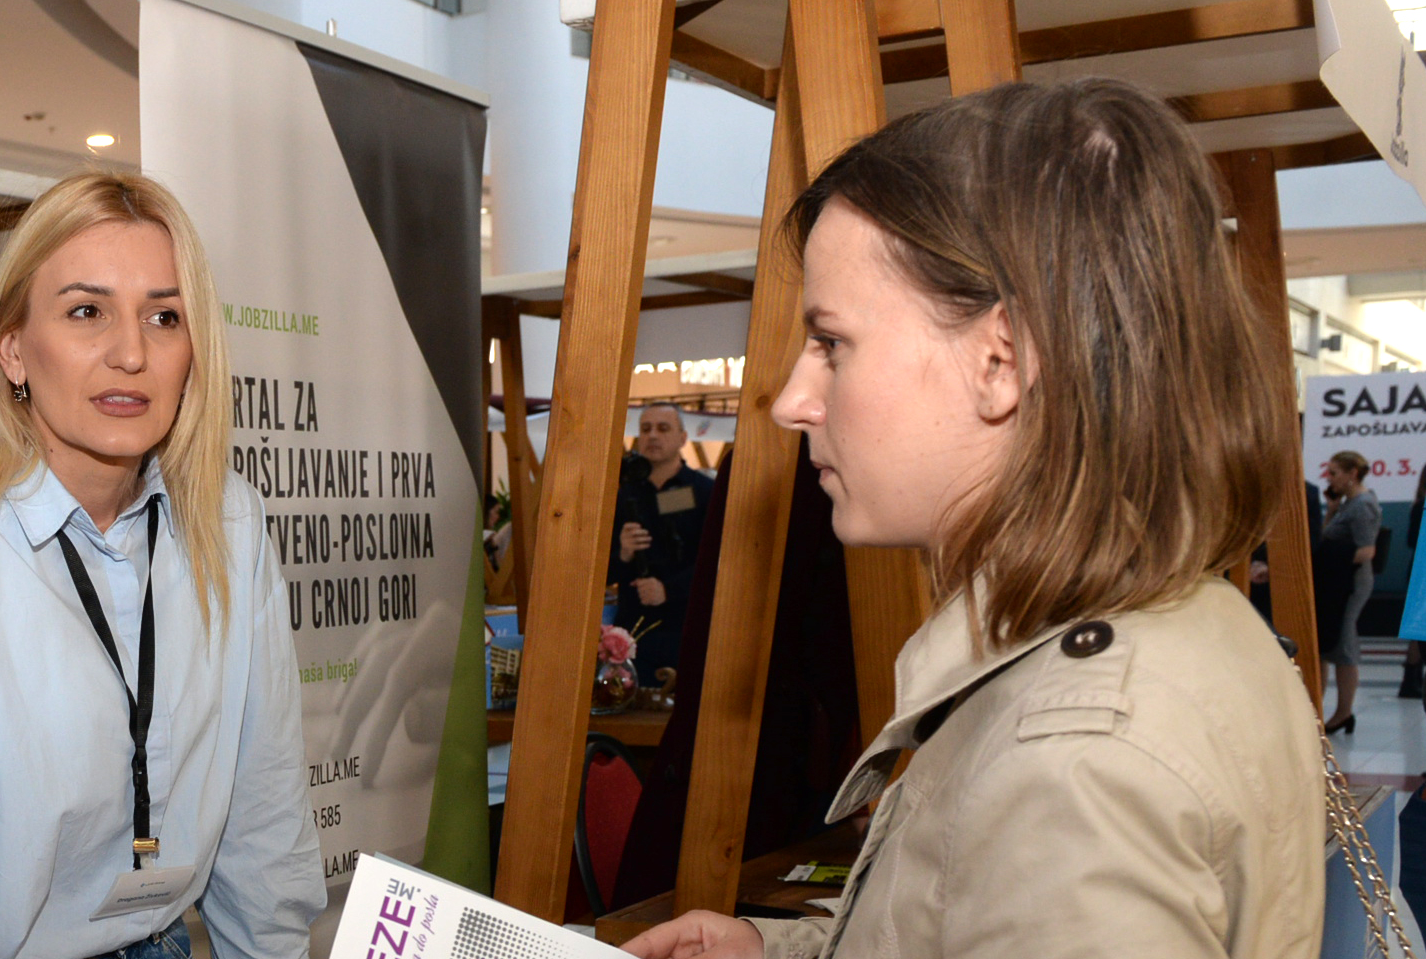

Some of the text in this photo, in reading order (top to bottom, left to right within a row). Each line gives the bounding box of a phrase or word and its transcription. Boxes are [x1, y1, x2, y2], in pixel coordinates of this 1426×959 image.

[294, 380, 318, 432] ZA
[377, 451, 384, 498] I
[391, 452, 436, 498] PRVA
[289, 574, 417, 631] U CRNOJ GORI
[327, 658, 358, 684] briga!
[309, 756, 360, 787] ZILLA.ME
[321, 804, 341, 829] 585
[416, 934, 427, 953] do
[424, 894, 439, 934] posla
